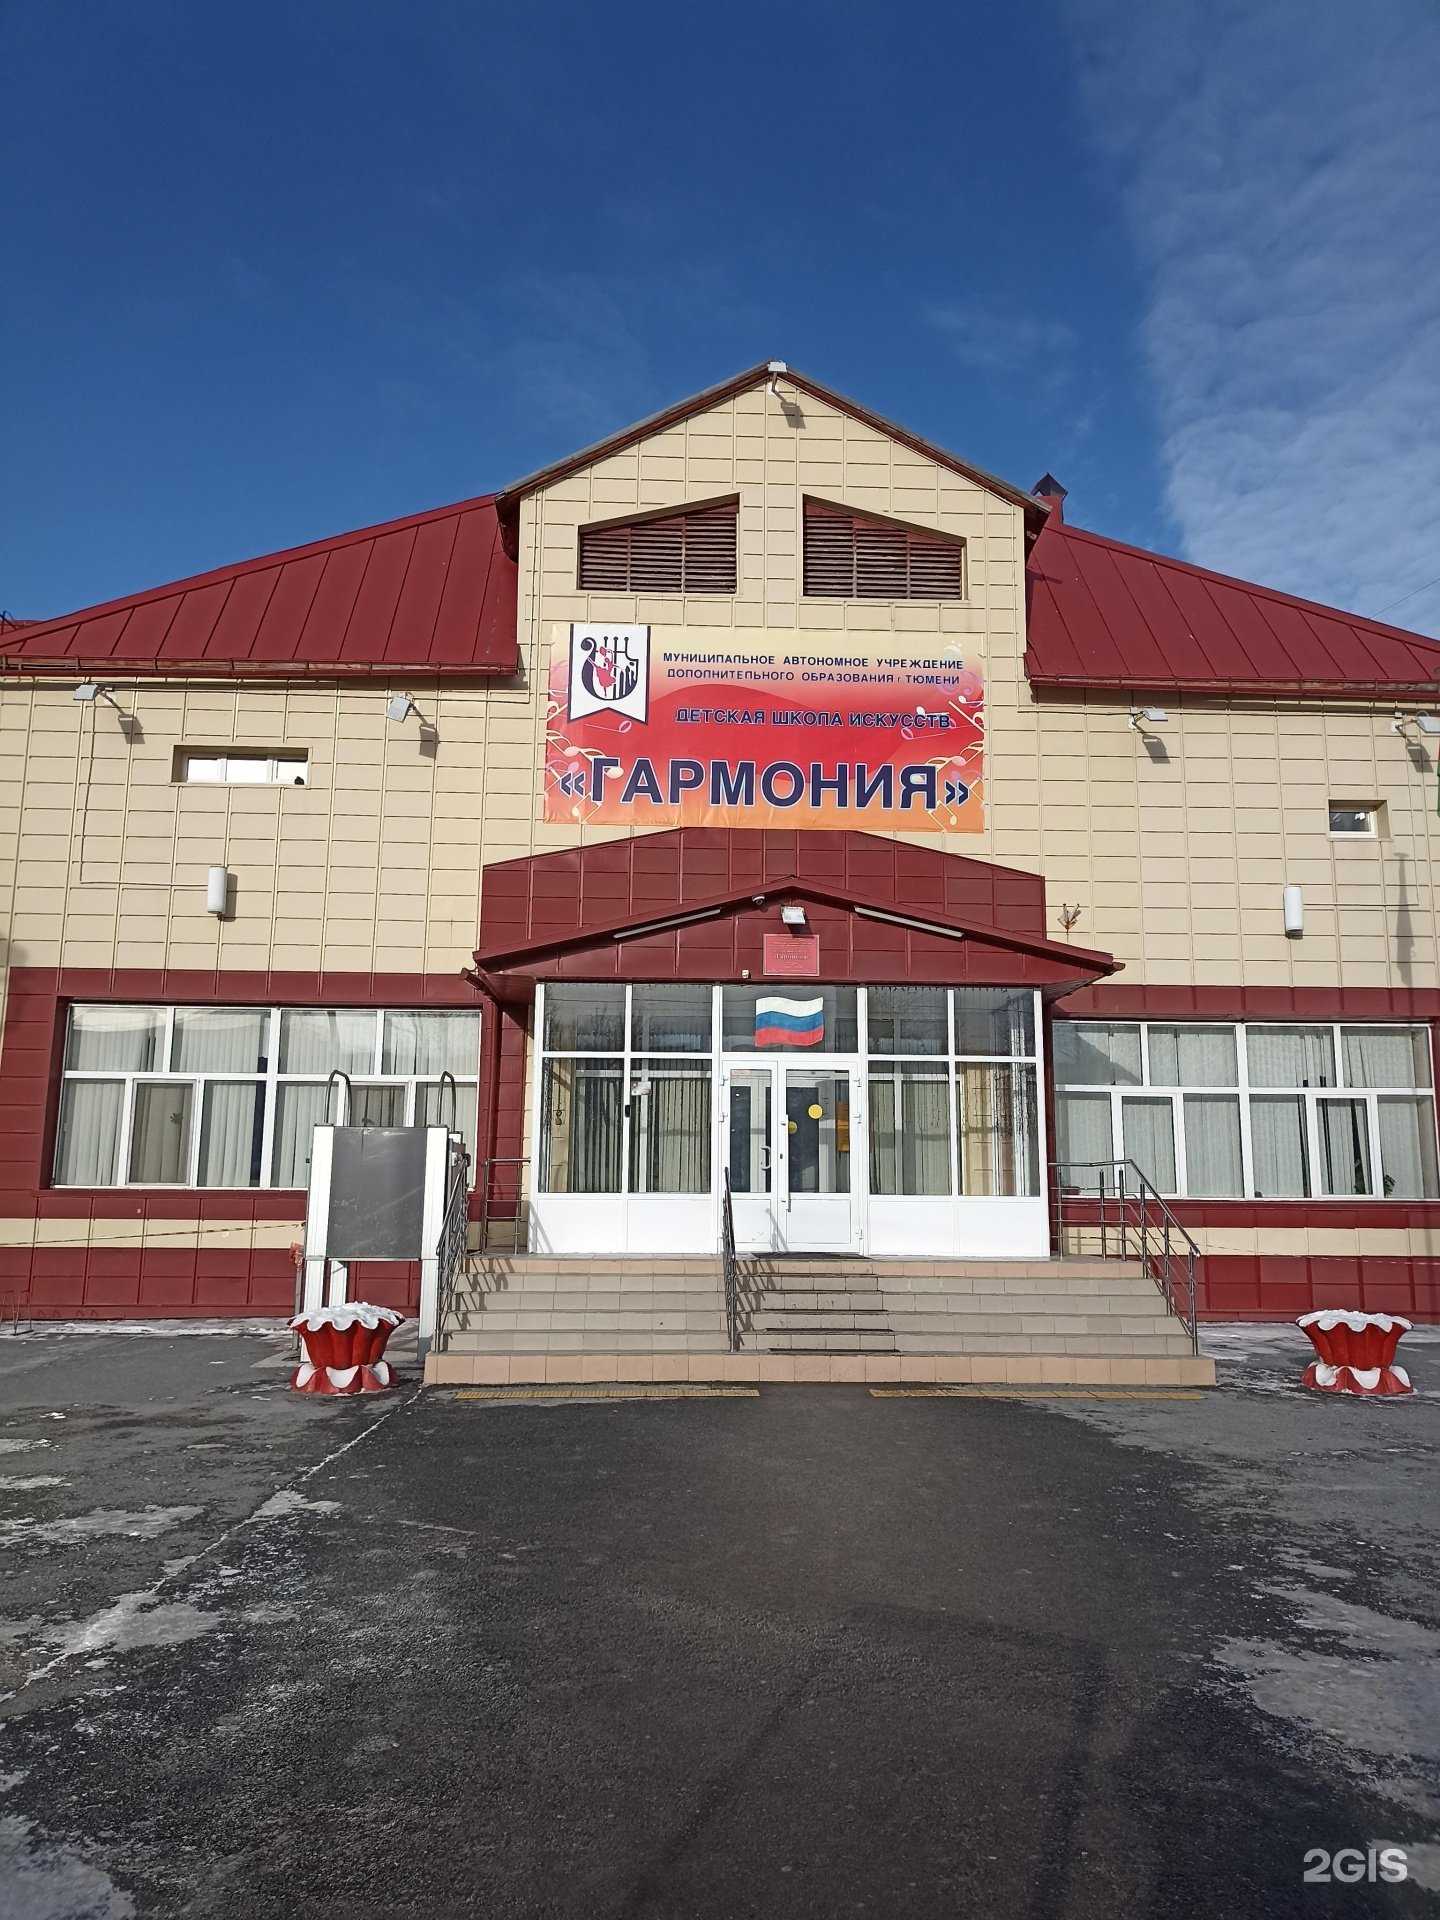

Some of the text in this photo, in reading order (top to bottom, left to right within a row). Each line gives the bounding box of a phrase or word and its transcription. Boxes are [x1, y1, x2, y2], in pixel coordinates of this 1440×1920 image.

[663, 652, 964, 670] МУНИЦИПАЛЬНОЕ АВТОНОМНОЕ УЧРЕЖДЕНИЕ
[667, 668, 795, 681] ДОПОЛНИТЕЛЬНОГО
[801, 672, 894, 684] ОБРАЗОВАНИЯ
[905, 674, 960, 685] ТЮМЕНИ
[676, 707, 951, 729] ДЕТСКАЯ ШКОЛА ИСКУССТВ
[558, 757, 970, 811] «ГАРМОНИЯ»
